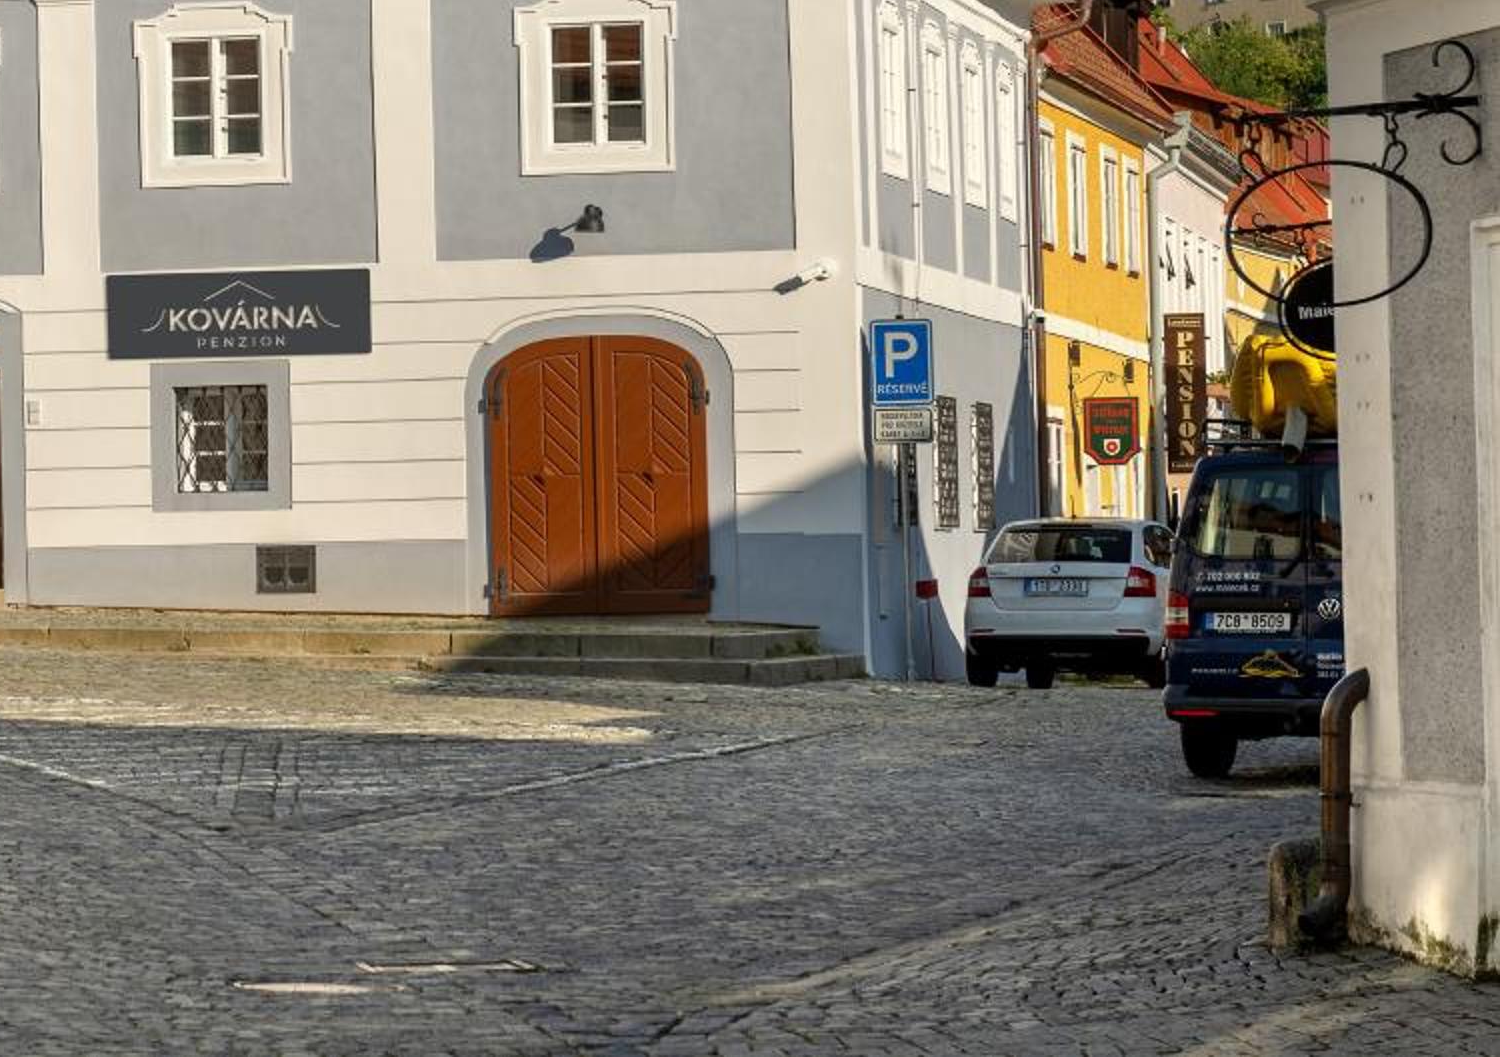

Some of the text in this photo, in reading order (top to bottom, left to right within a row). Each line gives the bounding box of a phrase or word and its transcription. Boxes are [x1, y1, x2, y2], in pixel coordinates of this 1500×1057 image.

[169, 300, 317, 332] KOVÁRNA
[197, 335, 285, 349] PENZION
[884, 331, 919, 378] P
[1176, 331, 1197, 456] PENSION
